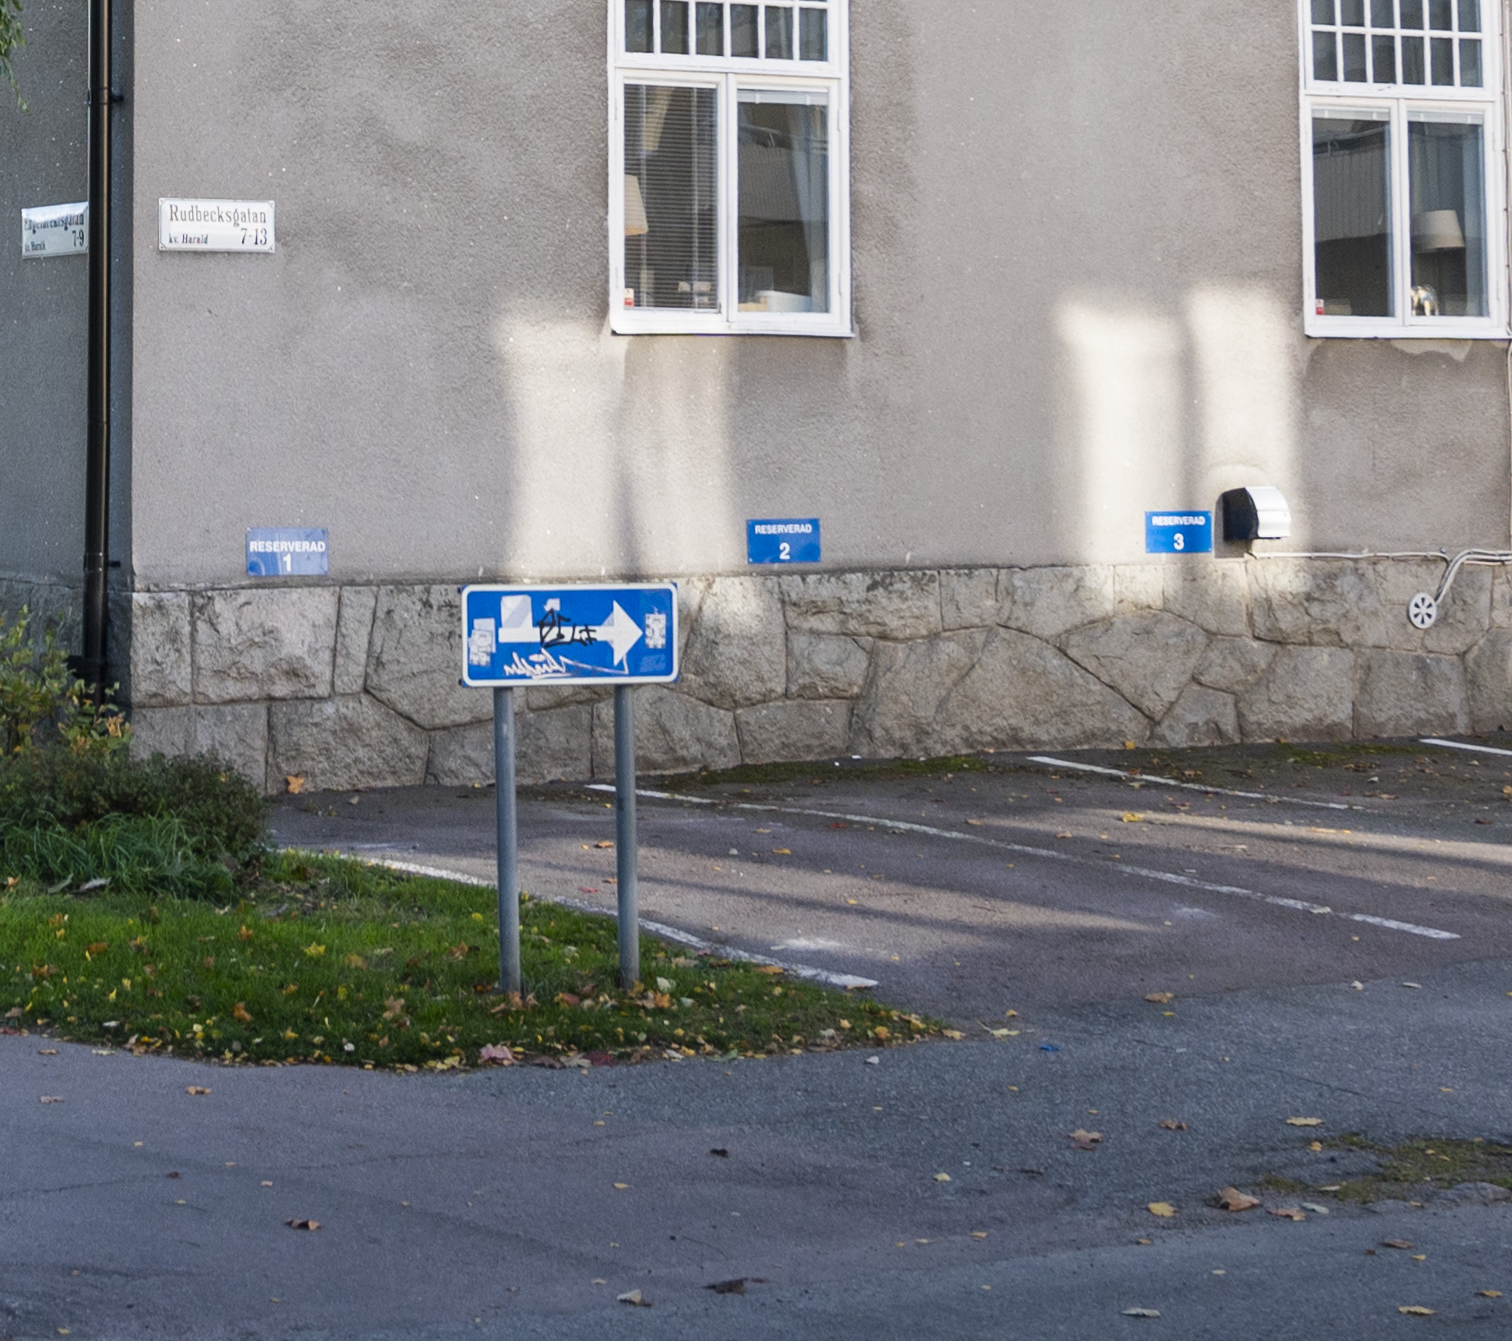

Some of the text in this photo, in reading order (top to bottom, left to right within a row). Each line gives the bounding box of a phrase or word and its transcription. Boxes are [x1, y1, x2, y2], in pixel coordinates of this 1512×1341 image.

[169, 204, 267, 227] Rudbecksgatan
[72, 229, 85, 247] 7-9
[182, 233, 208, 245] Harald
[240, 228, 268, 246] 7-13
[754, 523, 813, 535] RESERVERAD
[1151, 515, 1206, 526] RESERVERAD
[249, 540, 326, 553] RESERVERAD
[1173, 532, 1185, 550] 3
[779, 542, 791, 560] 2
[282, 553, 292, 572] 1
